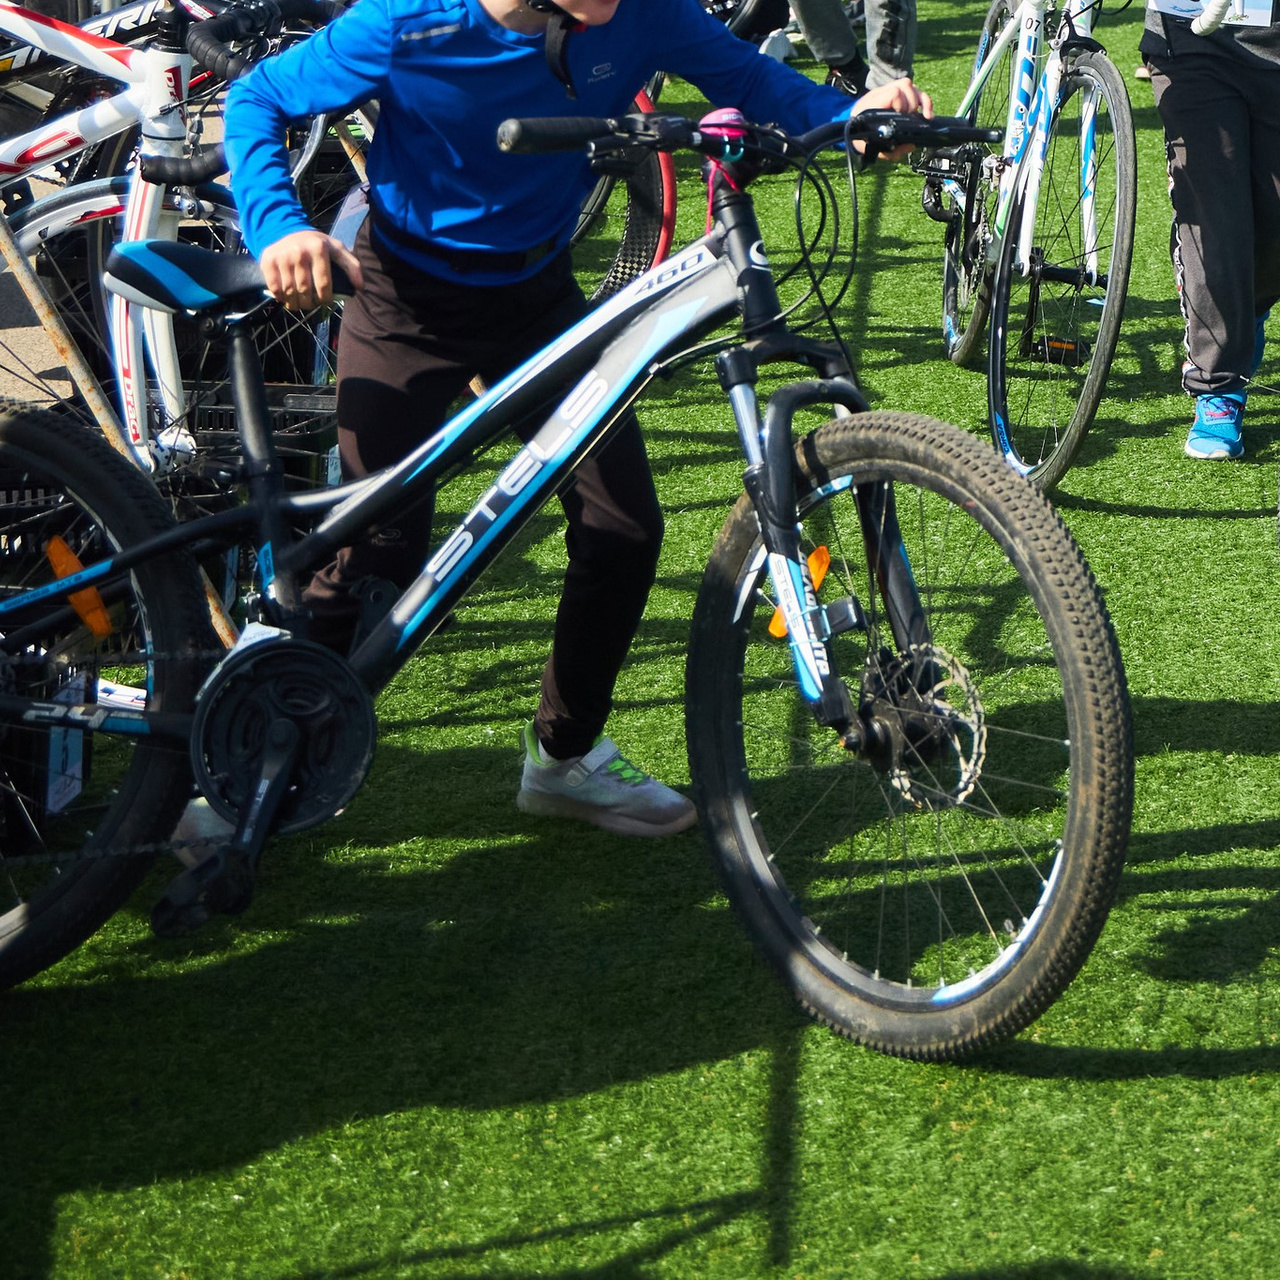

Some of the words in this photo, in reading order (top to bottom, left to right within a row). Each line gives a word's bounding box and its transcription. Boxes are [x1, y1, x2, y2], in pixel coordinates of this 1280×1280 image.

[1025, 17, 1041, 33] 07
[634, 253, 704, 296] 460
[426, 370, 608, 582] STELS
[774, 558, 800, 630] STELS
